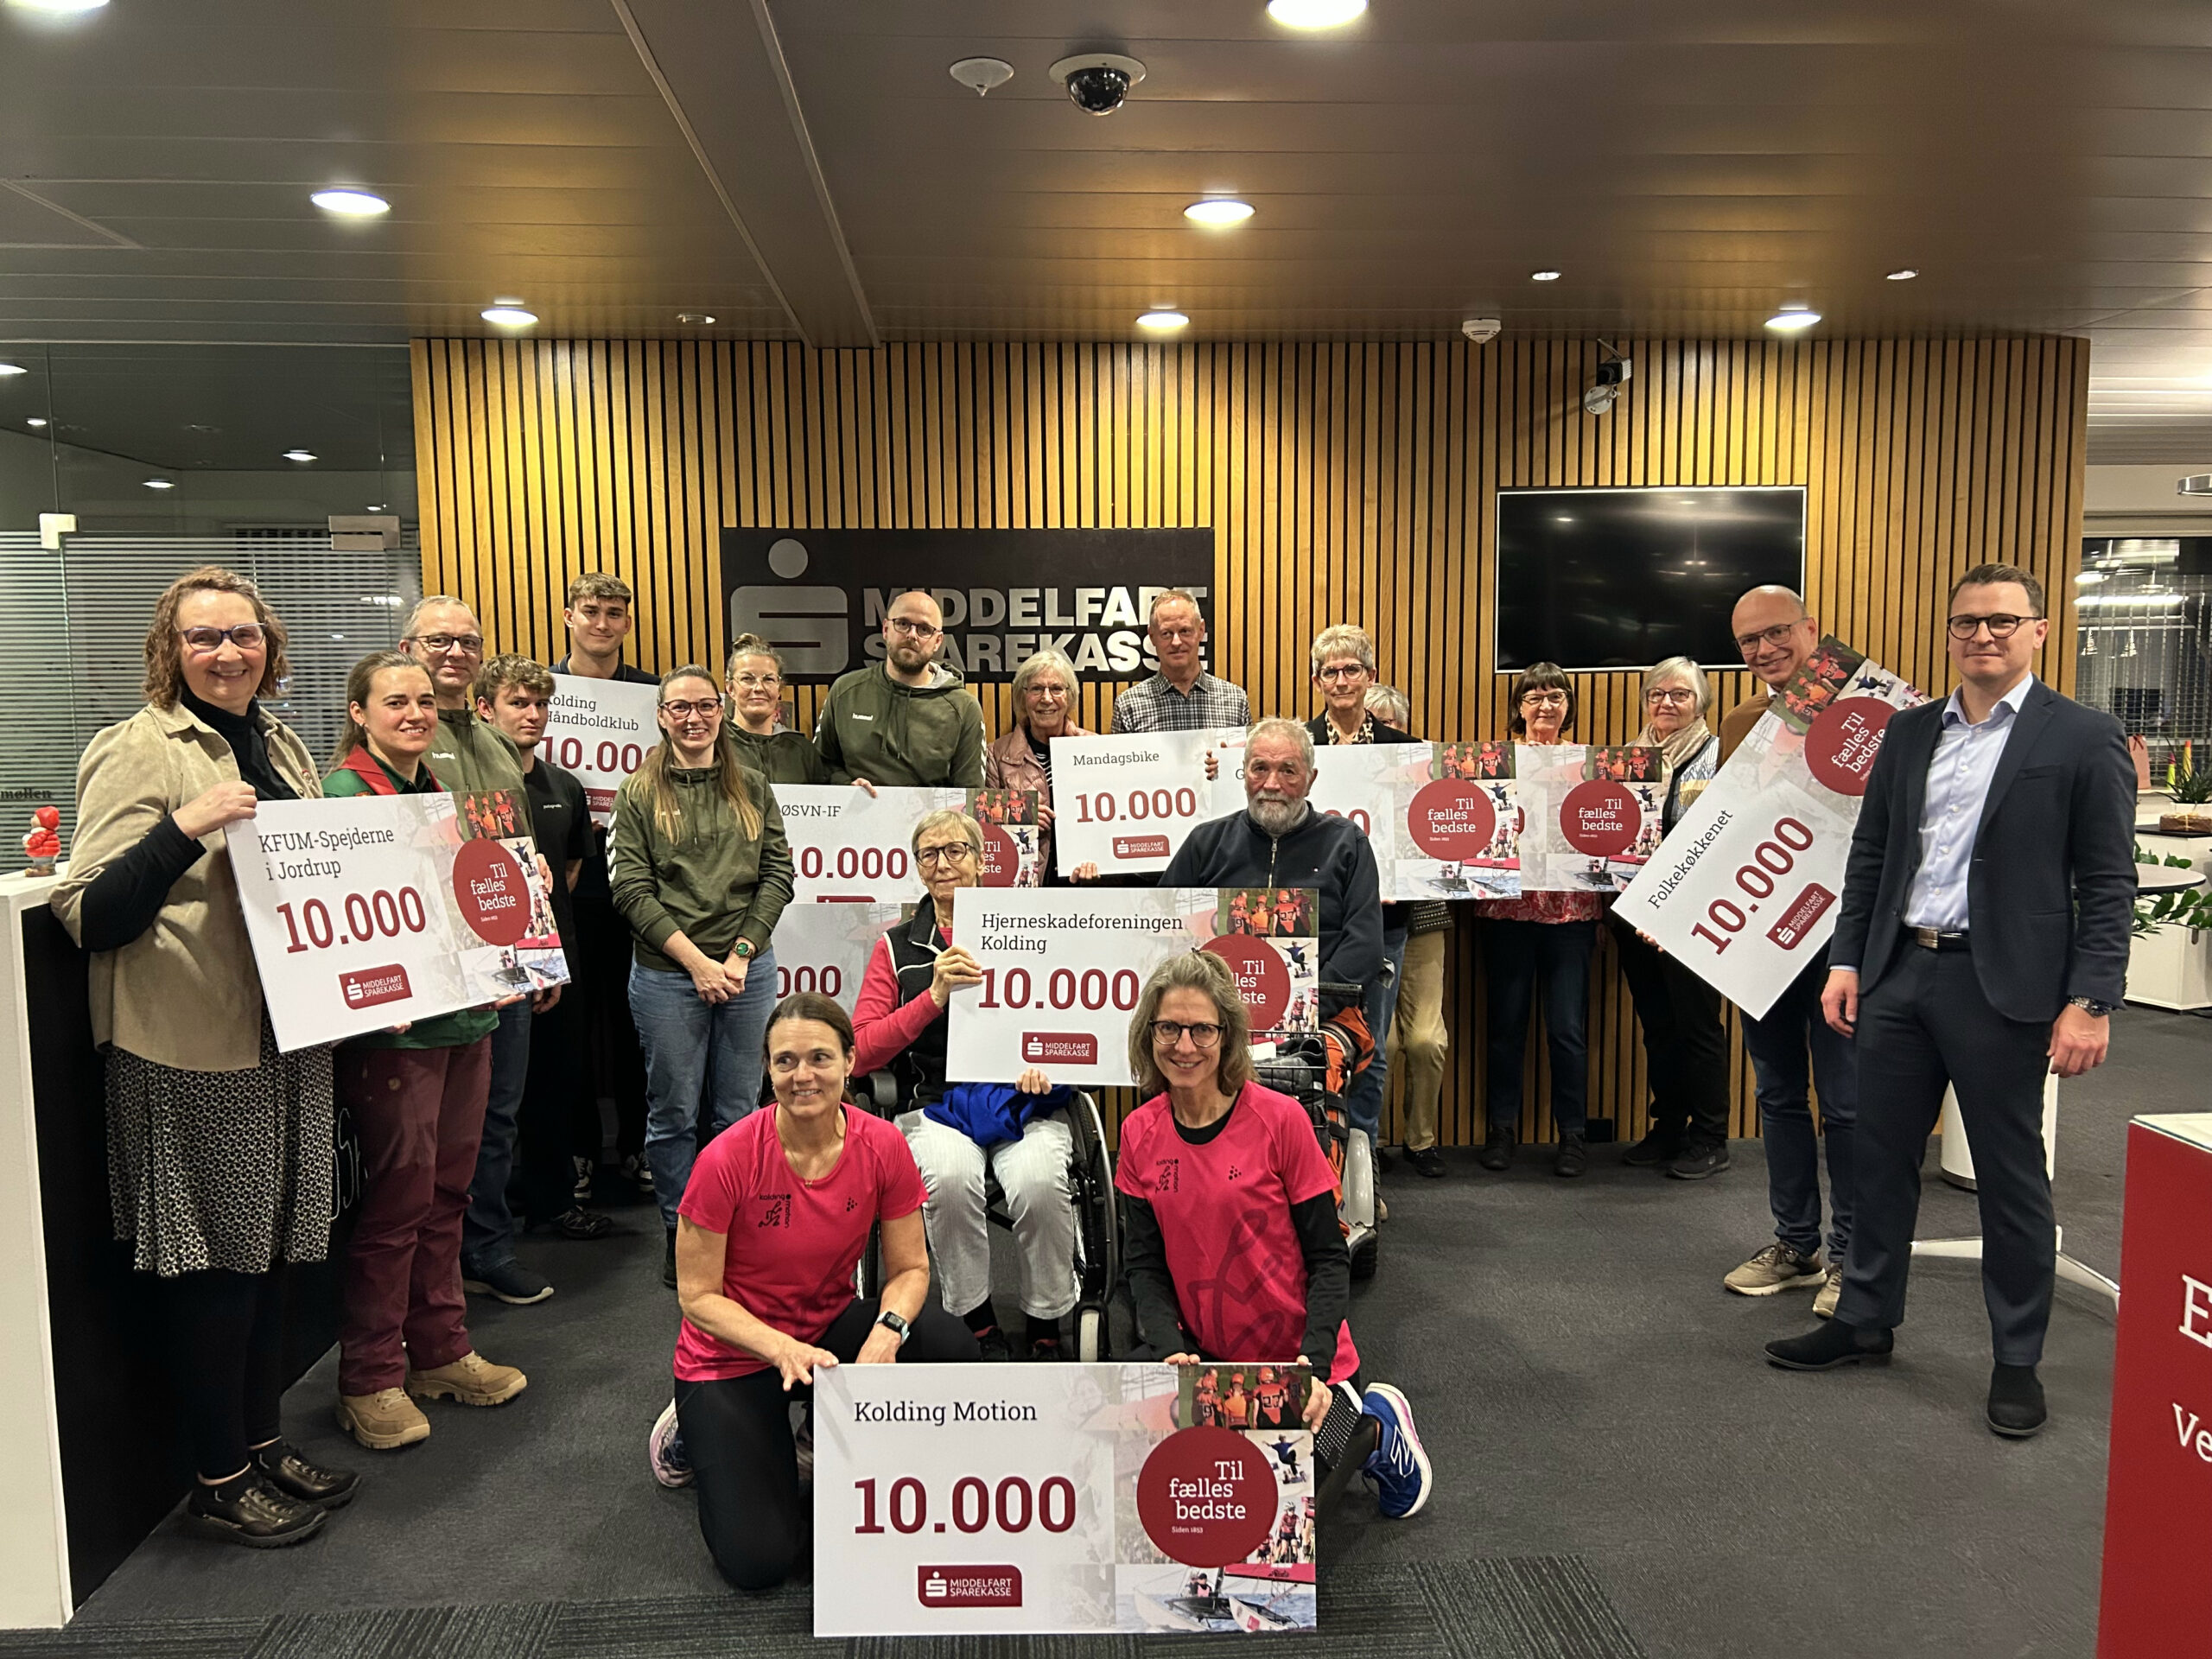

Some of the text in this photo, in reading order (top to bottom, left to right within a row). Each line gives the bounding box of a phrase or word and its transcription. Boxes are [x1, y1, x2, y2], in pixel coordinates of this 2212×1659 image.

[1840, 712, 1865, 733] Til
[540, 736, 657, 774] 10.00
[1831, 727, 1870, 768] fælles
[1846, 728, 1885, 772] bedste
[1073, 751, 1160, 766] Mandagsbike
[781, 804, 841, 817] ØSVN-IF
[1075, 787, 1197, 823] 10.000
[1455, 798, 1475, 810] Til
[1579, 807, 1616, 818] fælles
[1605, 798, 1623, 810] Til
[1427, 809, 1468, 820] fælles
[1432, 822, 1476, 833] bedste
[1582, 820, 1624, 831] bedste
[258, 828, 394, 853] KFUM-Spejderne
[985, 842, 1001, 852] Til
[1648, 809, 1733, 909] Folkekøkkenet
[266, 858, 341, 880] i Jordrup
[489, 862, 508, 879] Til
[984, 864, 1002, 874] ste
[470, 878, 506, 895] fælles
[1691, 817, 1814, 956] 10.000
[477, 893, 517, 911] bedste
[1788, 890, 1820, 927] MIDDELFART
[276, 886, 427, 954] 10.000
[1793, 895, 1826, 931] SPAREKASSE
[982, 913, 1183, 932] Hjerneskadeforeningen
[981, 936, 1047, 953] Kolding
[1243, 960, 1266, 975] Til
[363, 975, 403, 989] MIDDELFART
[364, 982, 404, 997] SPAREKASSE
[978, 968, 1140, 1010] 10.000
[1045, 1042, 1090, 1051] MIDDELFART
[854, 1400, 1037, 1427] Kolding Motion
[1215, 1460, 1244, 1480] Til
[1169, 1478, 1233, 1498] fælles
[855, 1476, 1077, 1534] 10.000
[1175, 1500, 1246, 1519] bedste
[950, 1579, 1012, 1587] MIDDELFART
[950, 1587, 1012, 1597] SPAREKASSE
